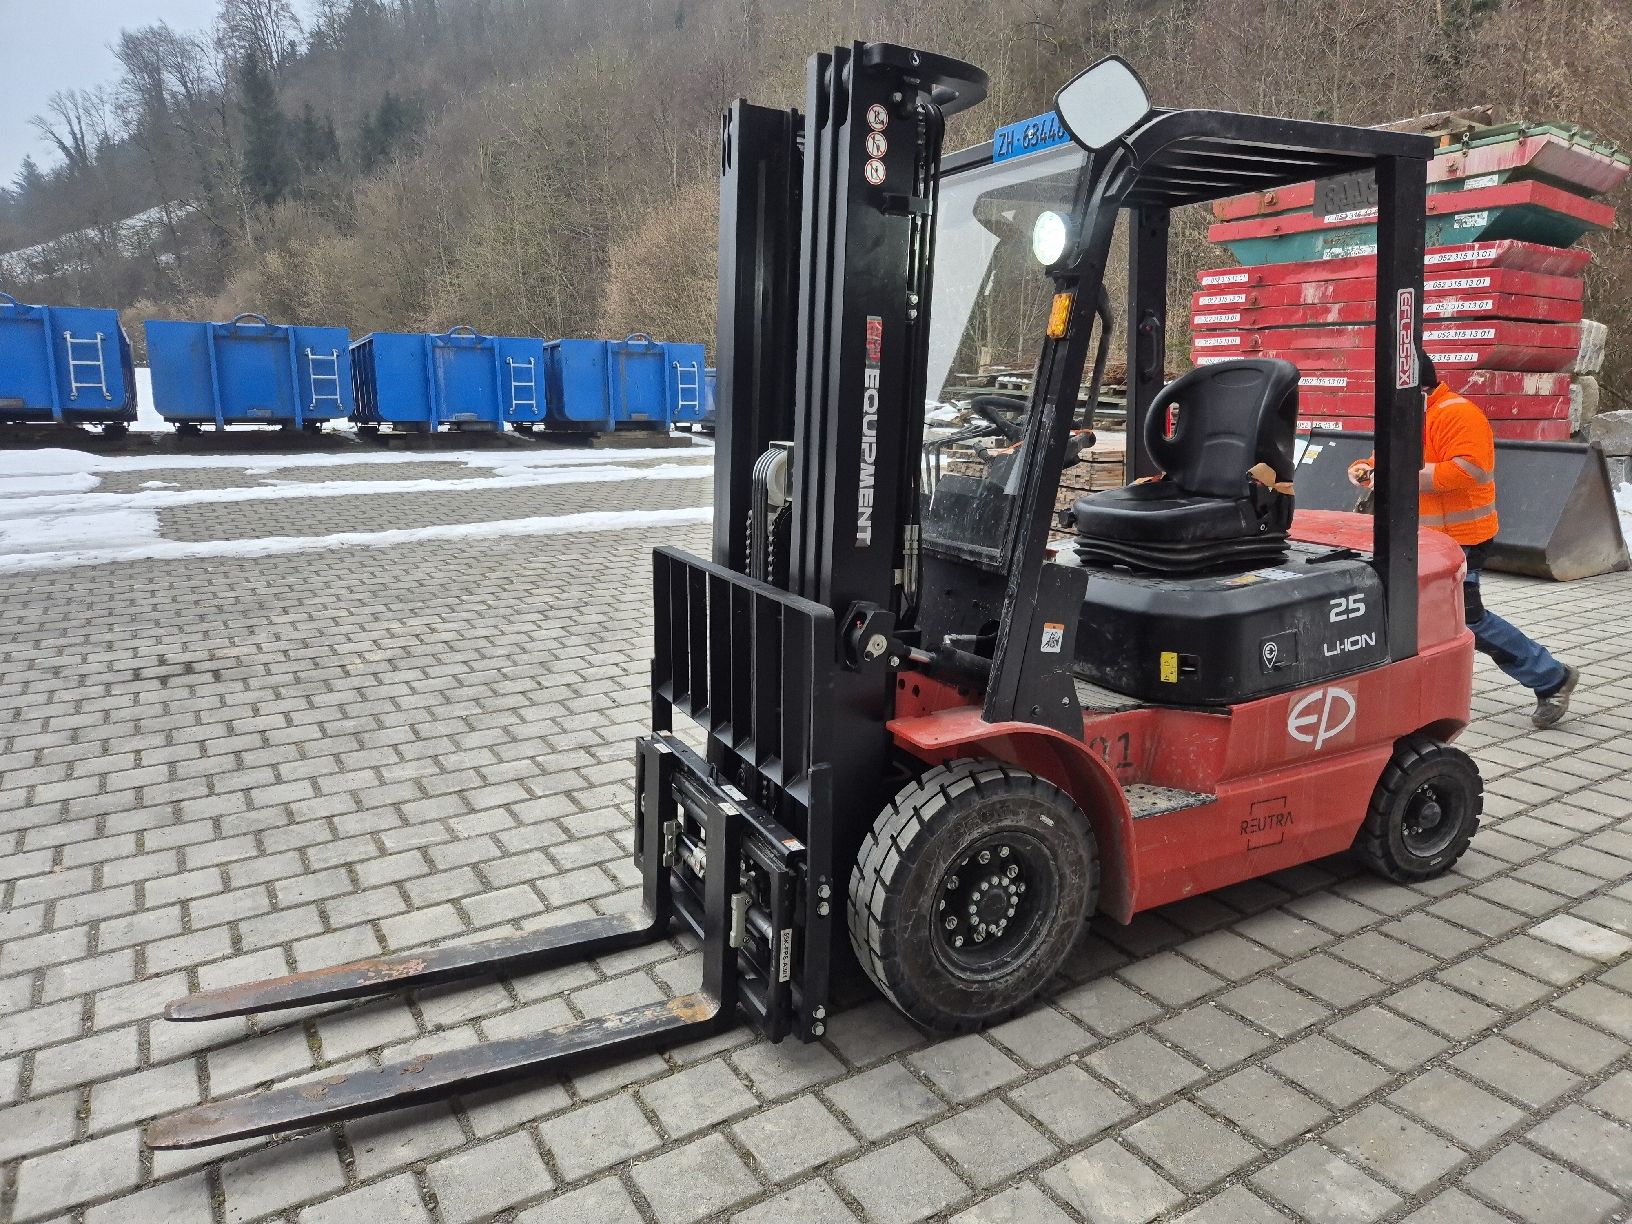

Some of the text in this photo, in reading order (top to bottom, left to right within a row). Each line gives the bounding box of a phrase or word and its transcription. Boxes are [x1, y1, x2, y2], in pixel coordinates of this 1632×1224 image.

[1471, 251, 1480, 259] 13
[1465, 279, 1474, 287] 13
[1476, 278, 1486, 286] 01
[1468, 301, 1477, 309] 13
[1399, 291, 1413, 386] EFL252X
[1469, 329, 1479, 337] 13
[1480, 328, 1490, 337] 01
[855, 368, 880, 546] EQUIPMENT
[1329, 593, 1366, 623] 25
[1323, 632, 1376, 657] LI-ION
[1287, 686, 1356, 750] EP
[1240, 811, 1294, 836] REUTRA
